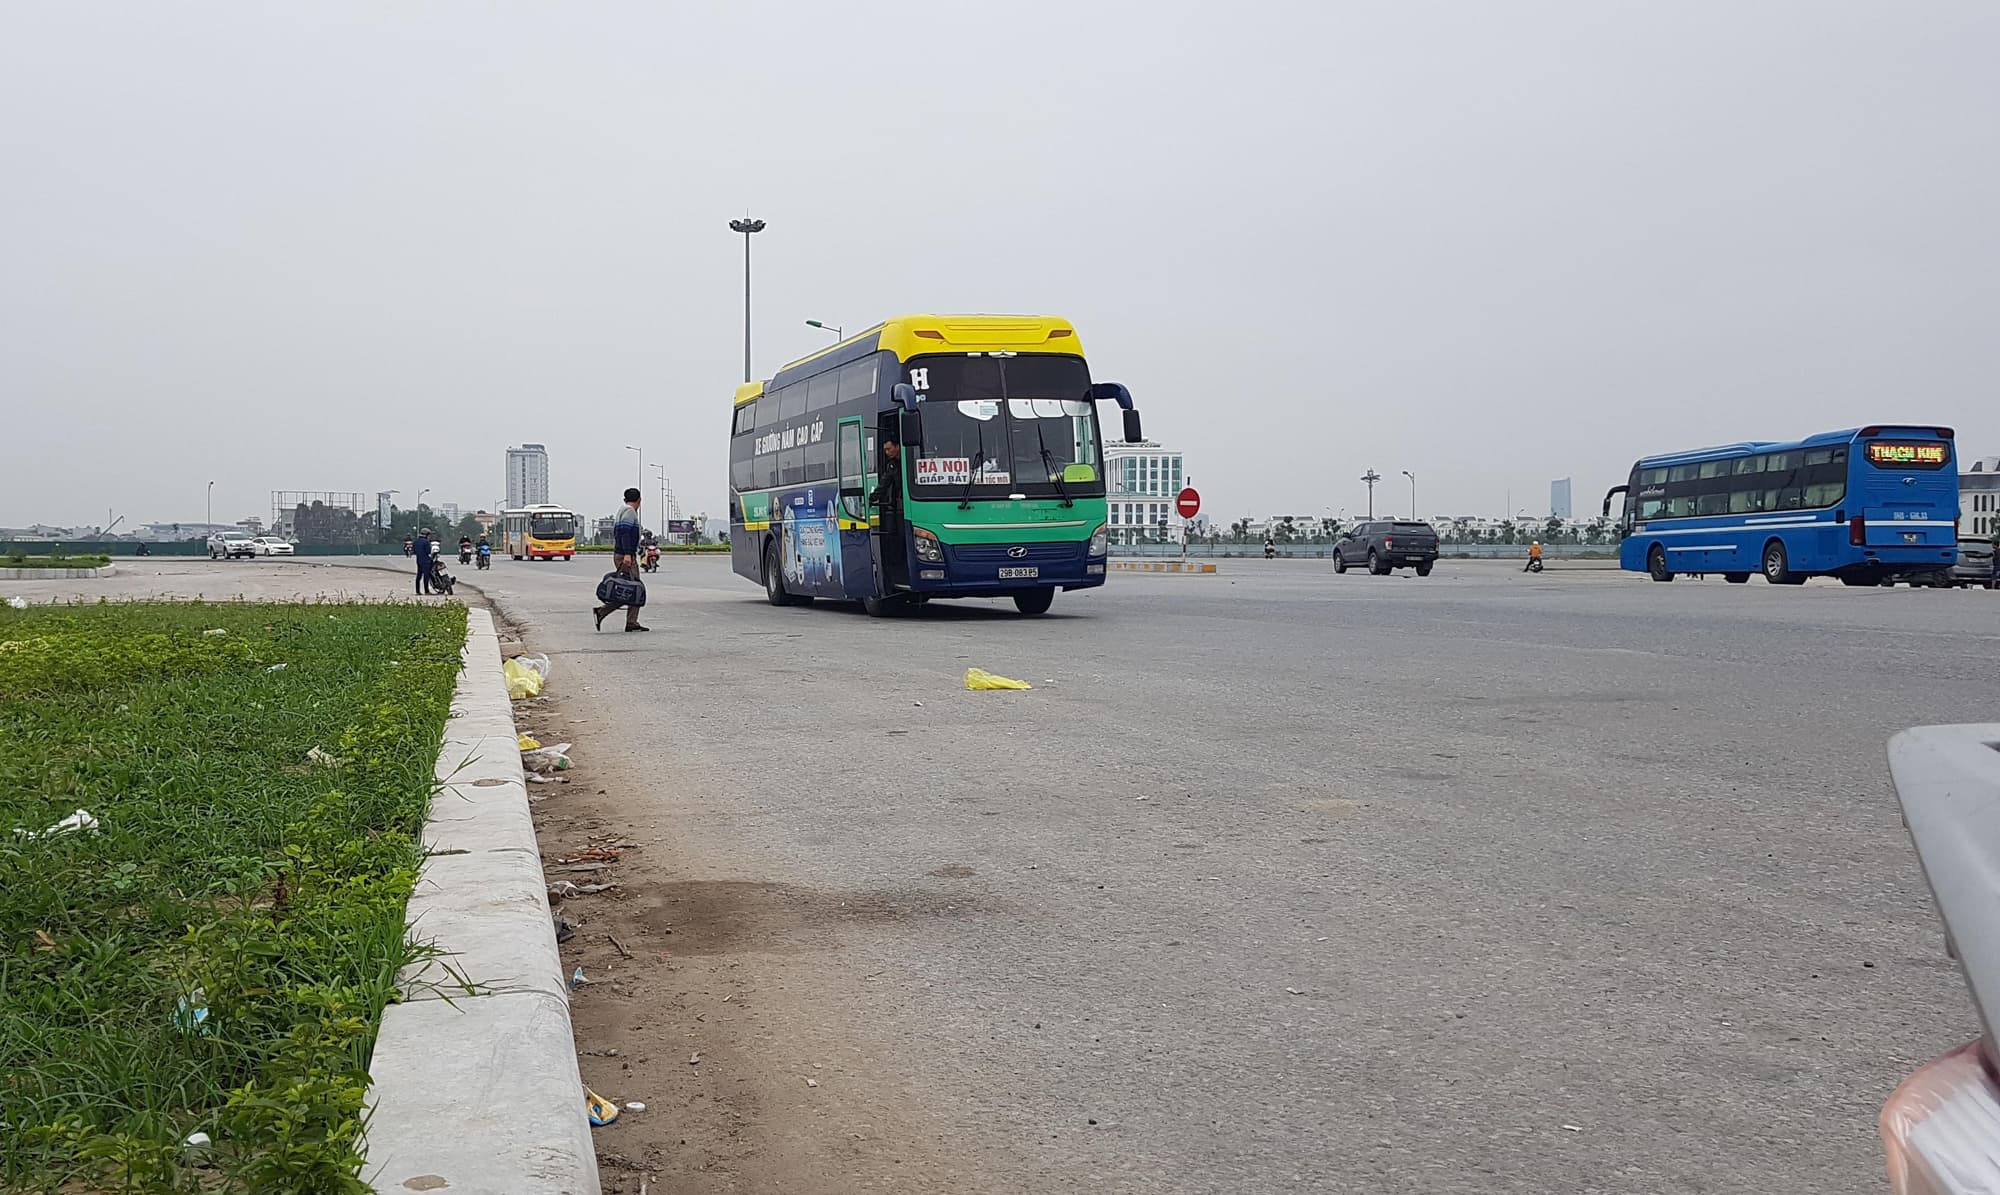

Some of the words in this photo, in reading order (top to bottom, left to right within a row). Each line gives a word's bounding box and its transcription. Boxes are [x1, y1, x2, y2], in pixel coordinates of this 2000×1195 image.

[797, 425, 808, 446] CAO
[811, 413, 824, 443] CẤP
[918, 459, 938, 473] HÀ
[943, 459, 968, 473] NỘI
[919, 473, 944, 484] GIÁP
